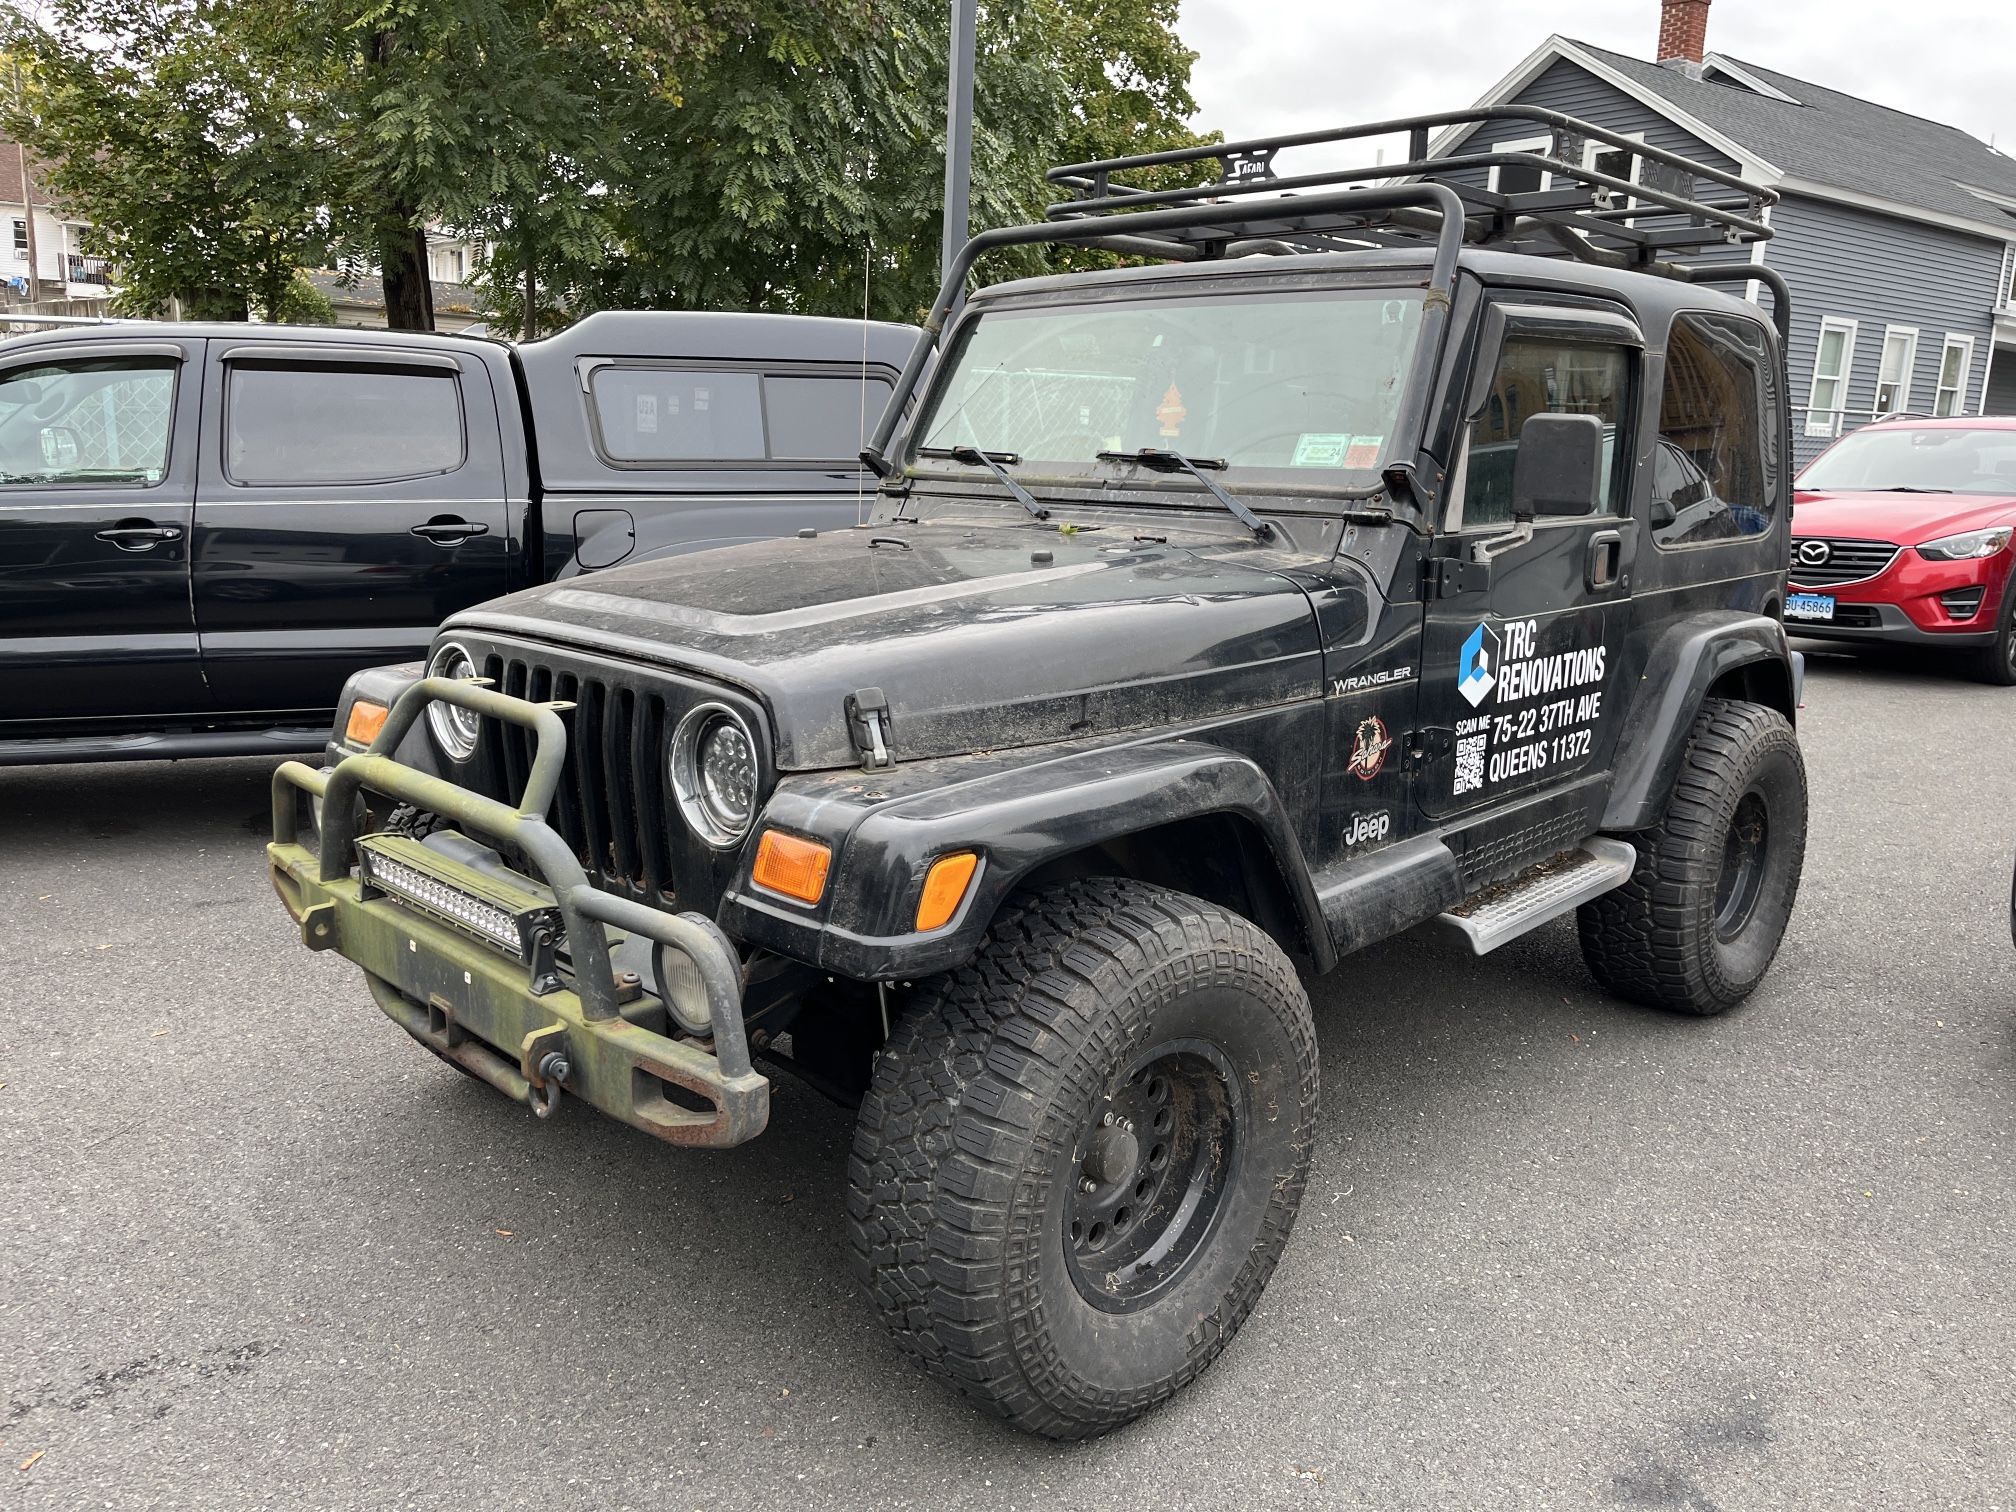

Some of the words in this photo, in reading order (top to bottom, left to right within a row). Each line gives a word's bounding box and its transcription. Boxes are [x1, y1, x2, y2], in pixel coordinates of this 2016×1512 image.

[1227, 159, 1264, 178] SAFARI
[1329, 448, 1341, 457] 24
[1503, 618, 1537, 661] TRC
[1333, 666, 1411, 694] WRANGLER
[1496, 645, 1606, 704] RENOVATIONS
[1455, 718, 1479, 737] SCAN
[1478, 714, 1491, 731] ME
[1492, 708, 1537, 746] 75-22
[1538, 698, 1575, 733] 37TH
[1575, 691, 1602, 723] AVE
[1349, 739, 1390, 768] Sahara
[1489, 739, 1548, 783] QUEENS
[1551, 728, 1592, 764] 11372
[1345, 814, 1390, 846] Jeep
